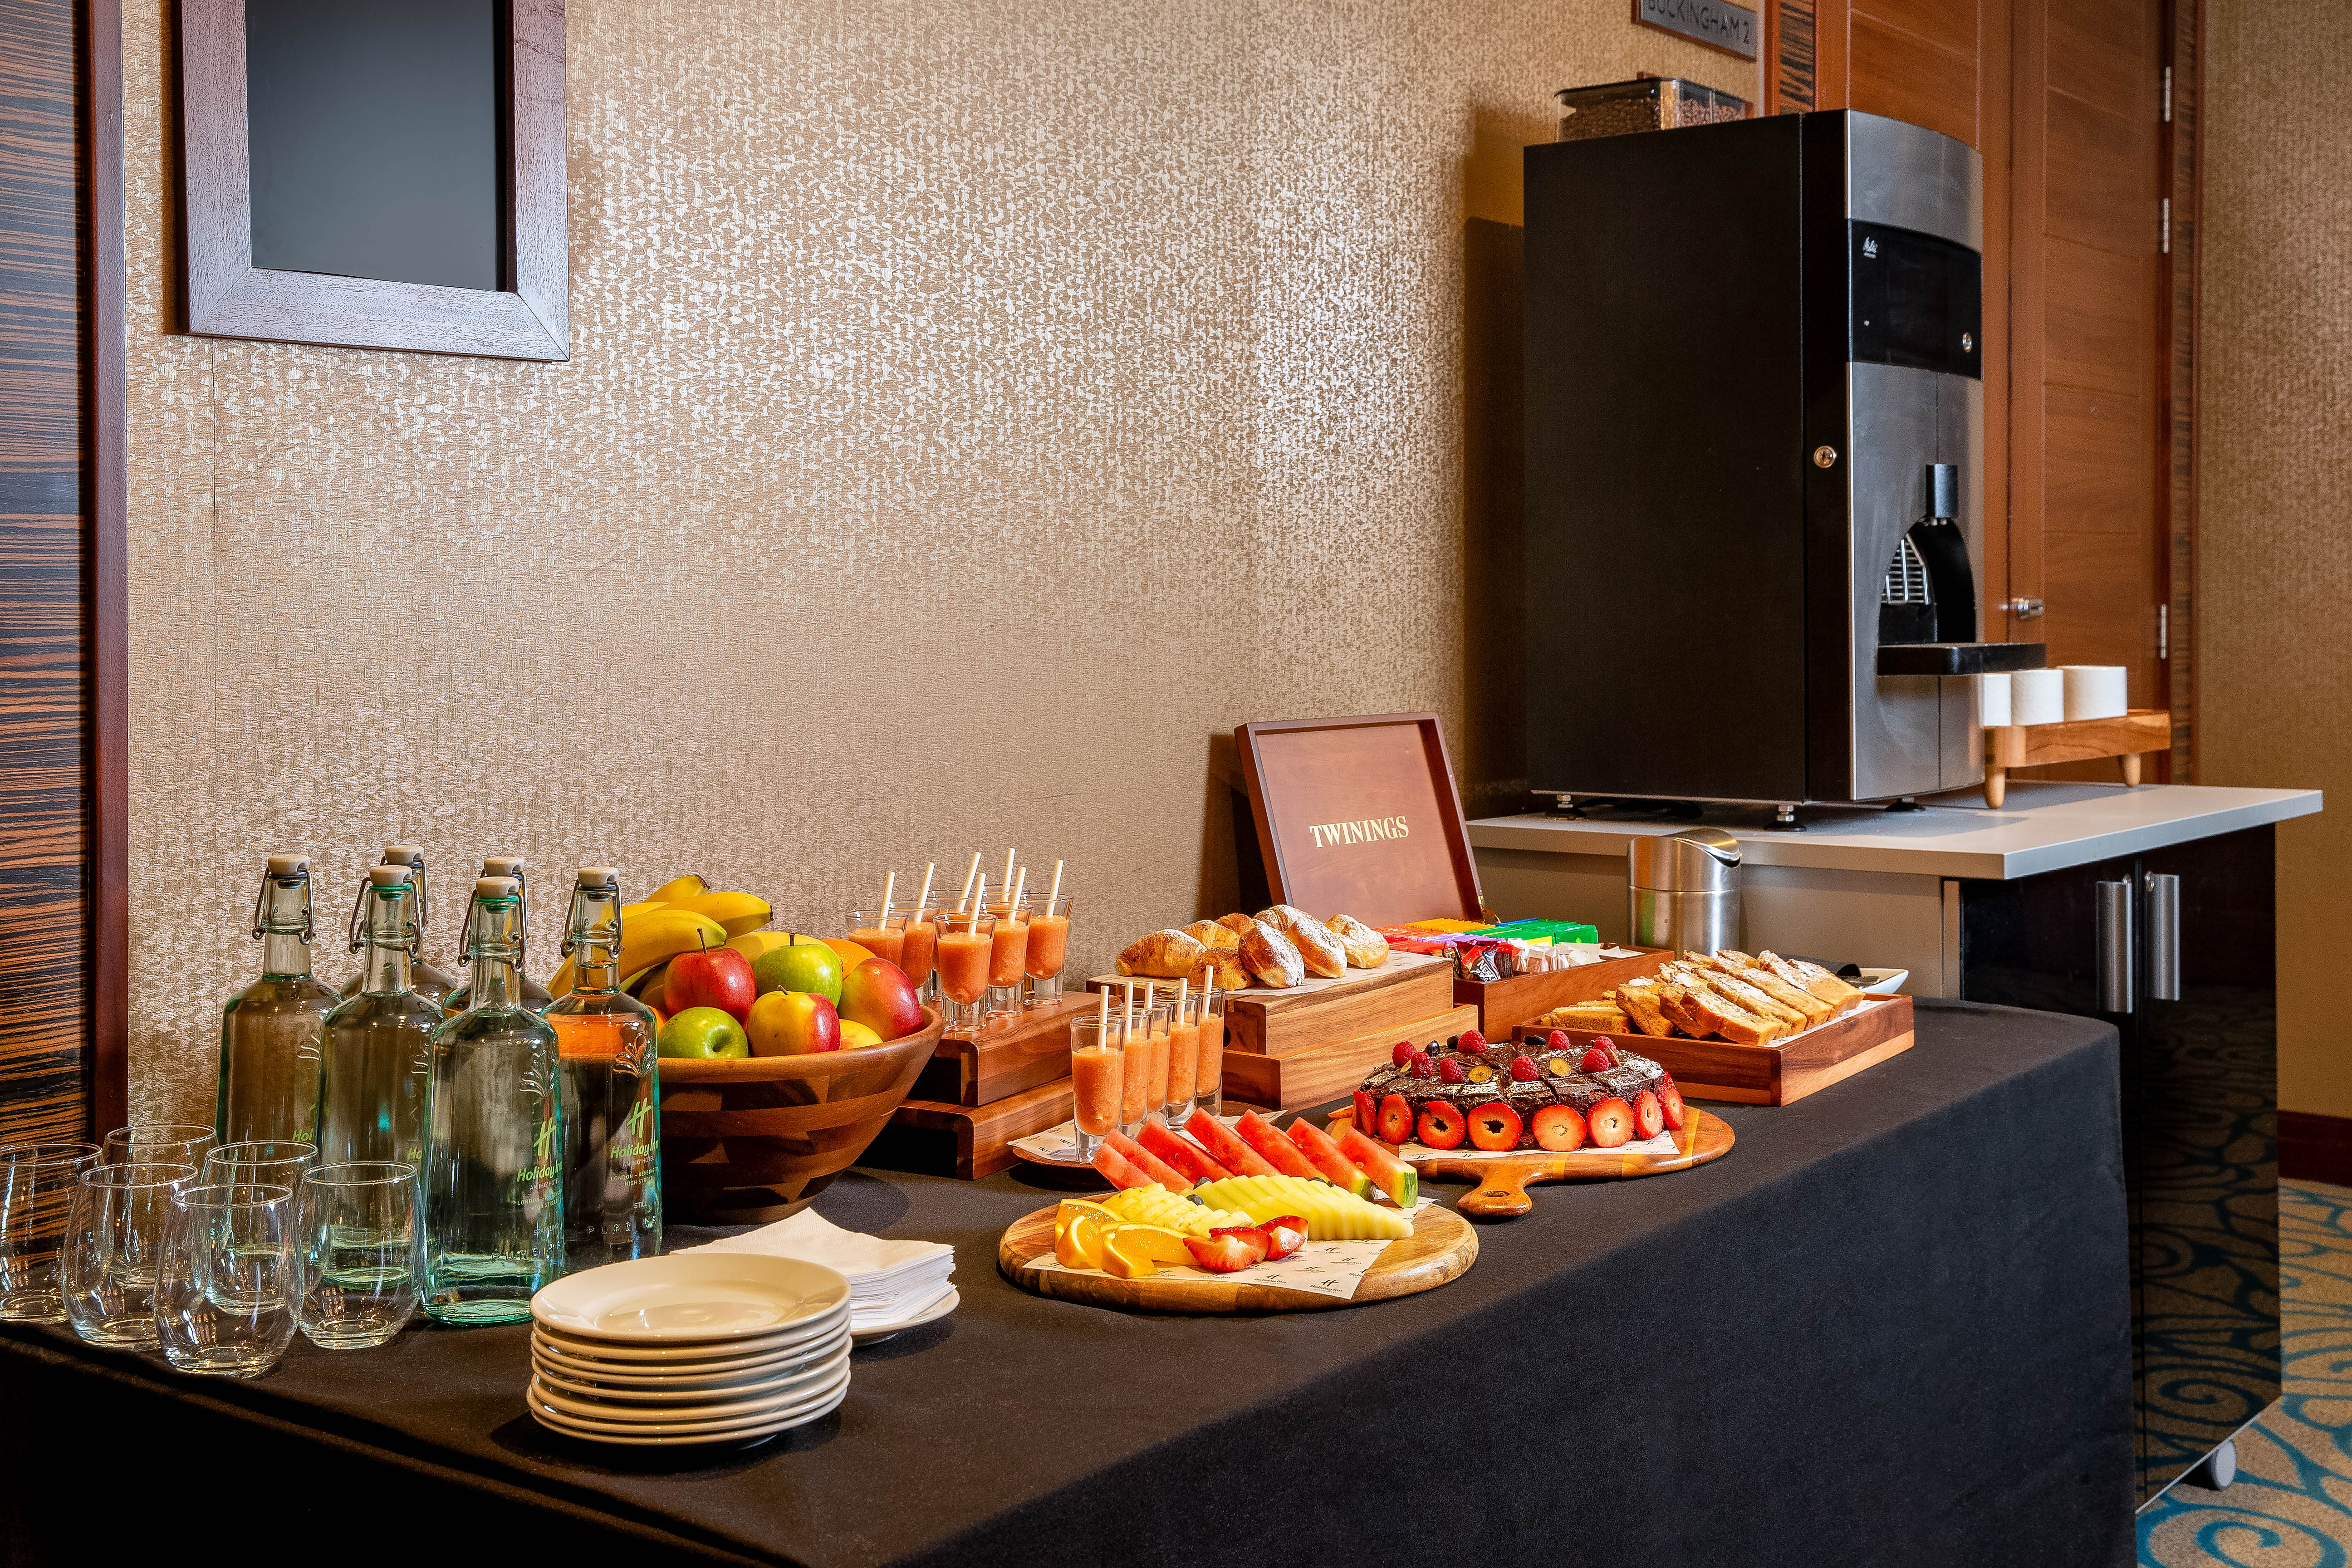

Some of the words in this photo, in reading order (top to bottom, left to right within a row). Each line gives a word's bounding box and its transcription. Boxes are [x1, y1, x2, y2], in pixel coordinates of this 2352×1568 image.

[1309, 816, 1409, 848] TWININGS
[610, 1142, 649, 1159] Holiday
[650, 1138, 659, 1151] Inn
[517, 1164, 554, 1182] Holiday
[549, 1178, 559, 1186] HOTEL
[638, 1176, 653, 1184] STREET
[517, 1198, 540, 1206] LONDON
[634, 1201, 647, 1209] STILL
